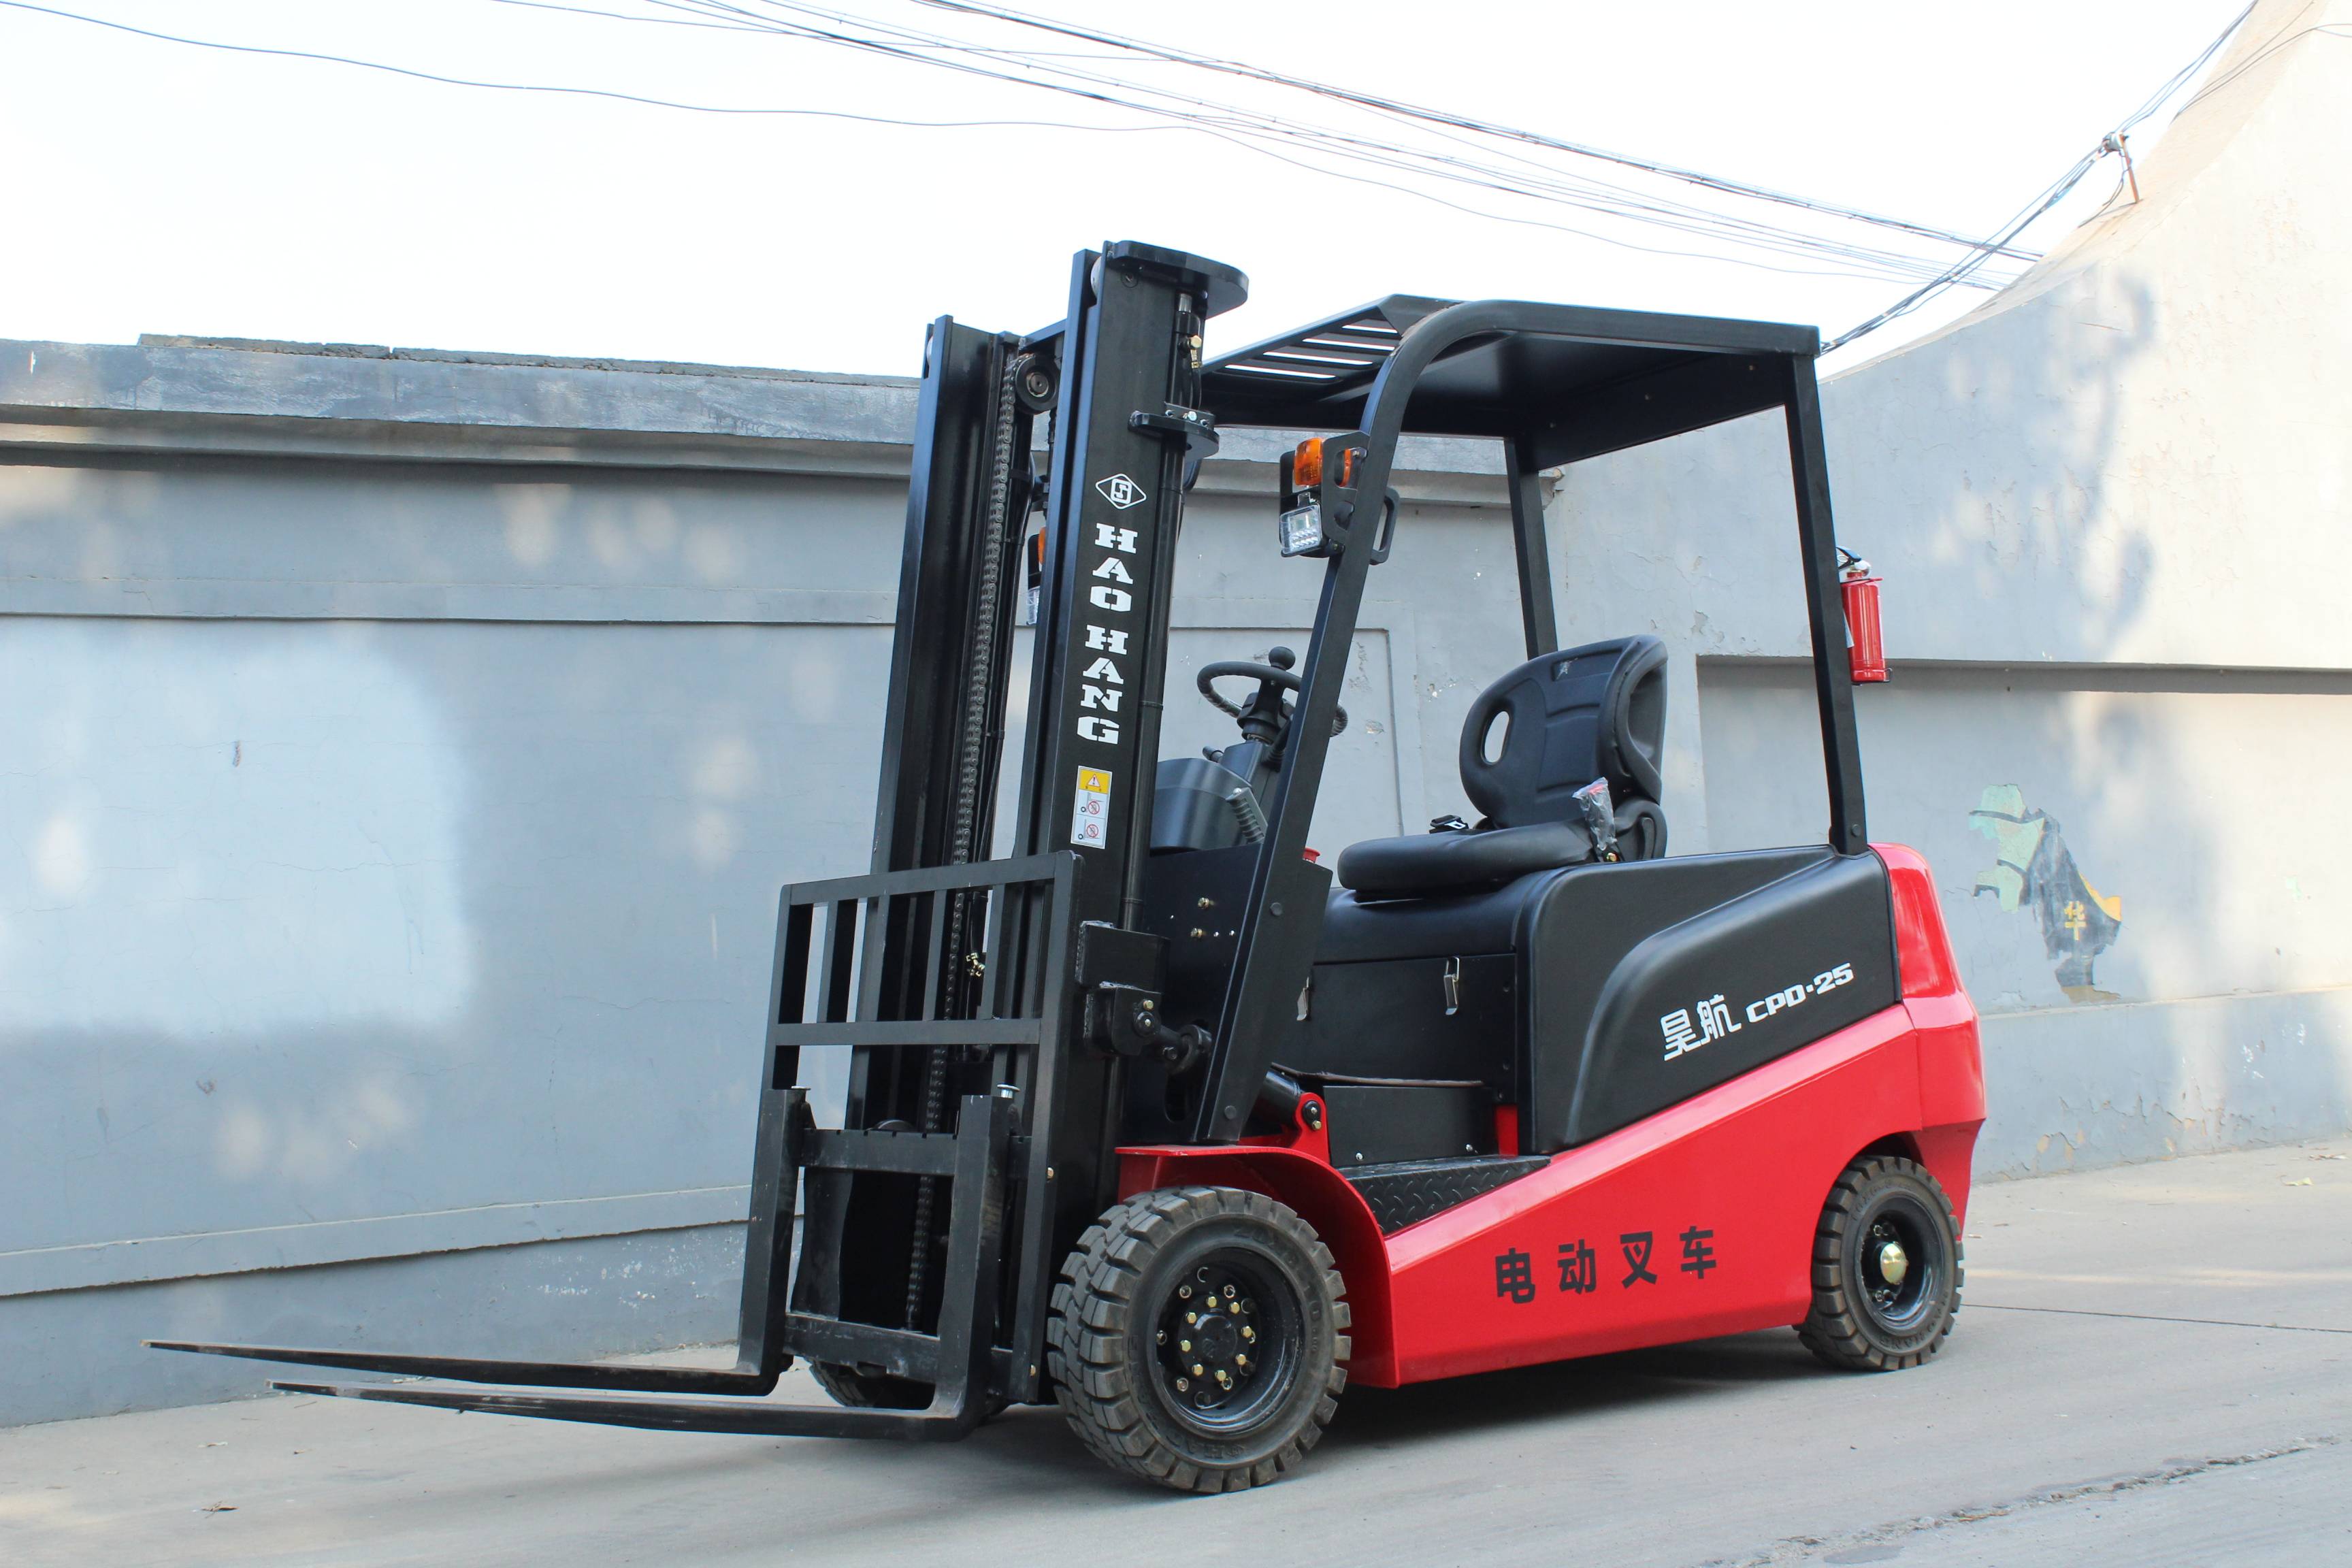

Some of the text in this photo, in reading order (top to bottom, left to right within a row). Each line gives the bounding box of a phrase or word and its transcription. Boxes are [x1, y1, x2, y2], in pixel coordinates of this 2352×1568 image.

[1077, 523, 1138, 745] HAO HANG
[1661, 994, 1742, 1061] 昊航
[1495, 1226, 1716, 1304] 电动叉车
